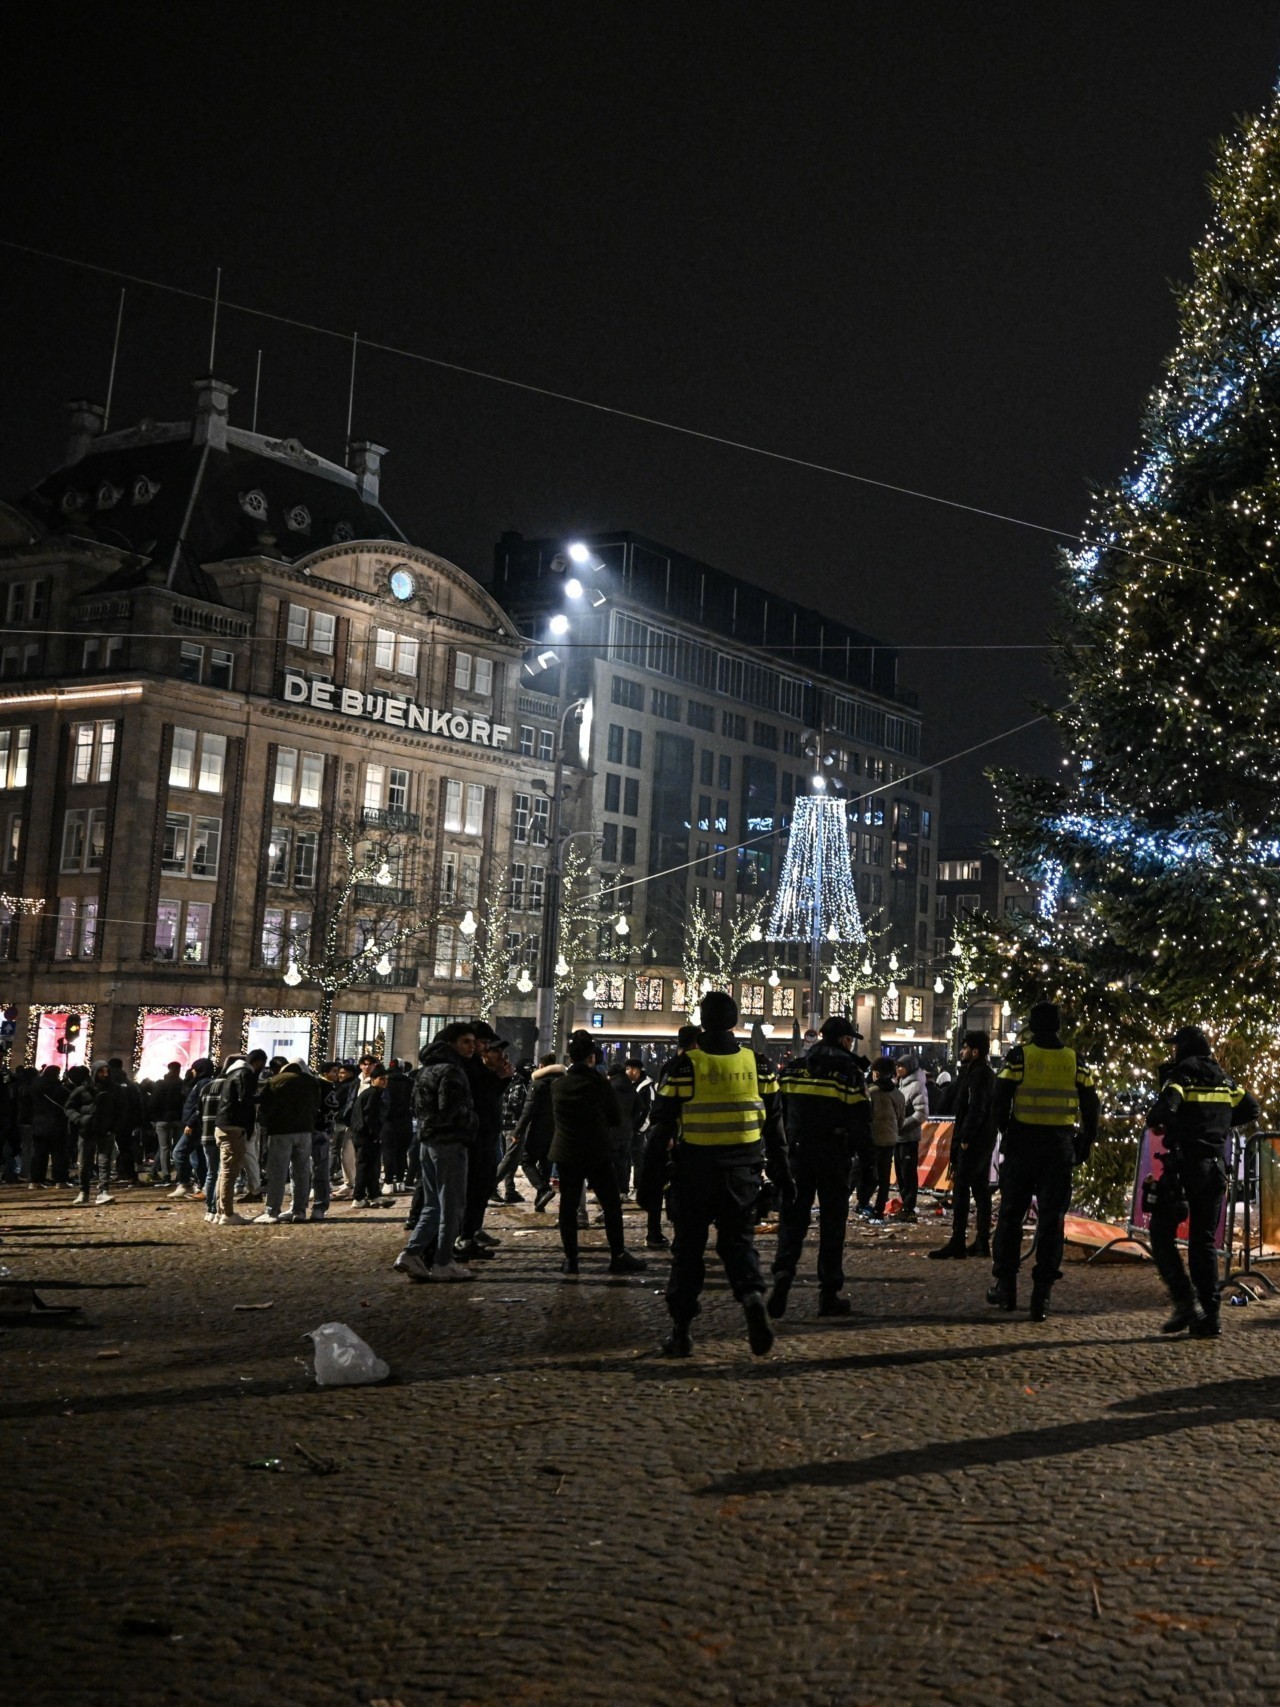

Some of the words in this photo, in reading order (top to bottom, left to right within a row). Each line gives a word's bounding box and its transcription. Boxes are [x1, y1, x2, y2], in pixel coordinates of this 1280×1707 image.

[283, 674, 335, 711] DE
[340, 687, 512, 748] BIJENKORF
[699, 1064, 754, 1084] POLITIE
